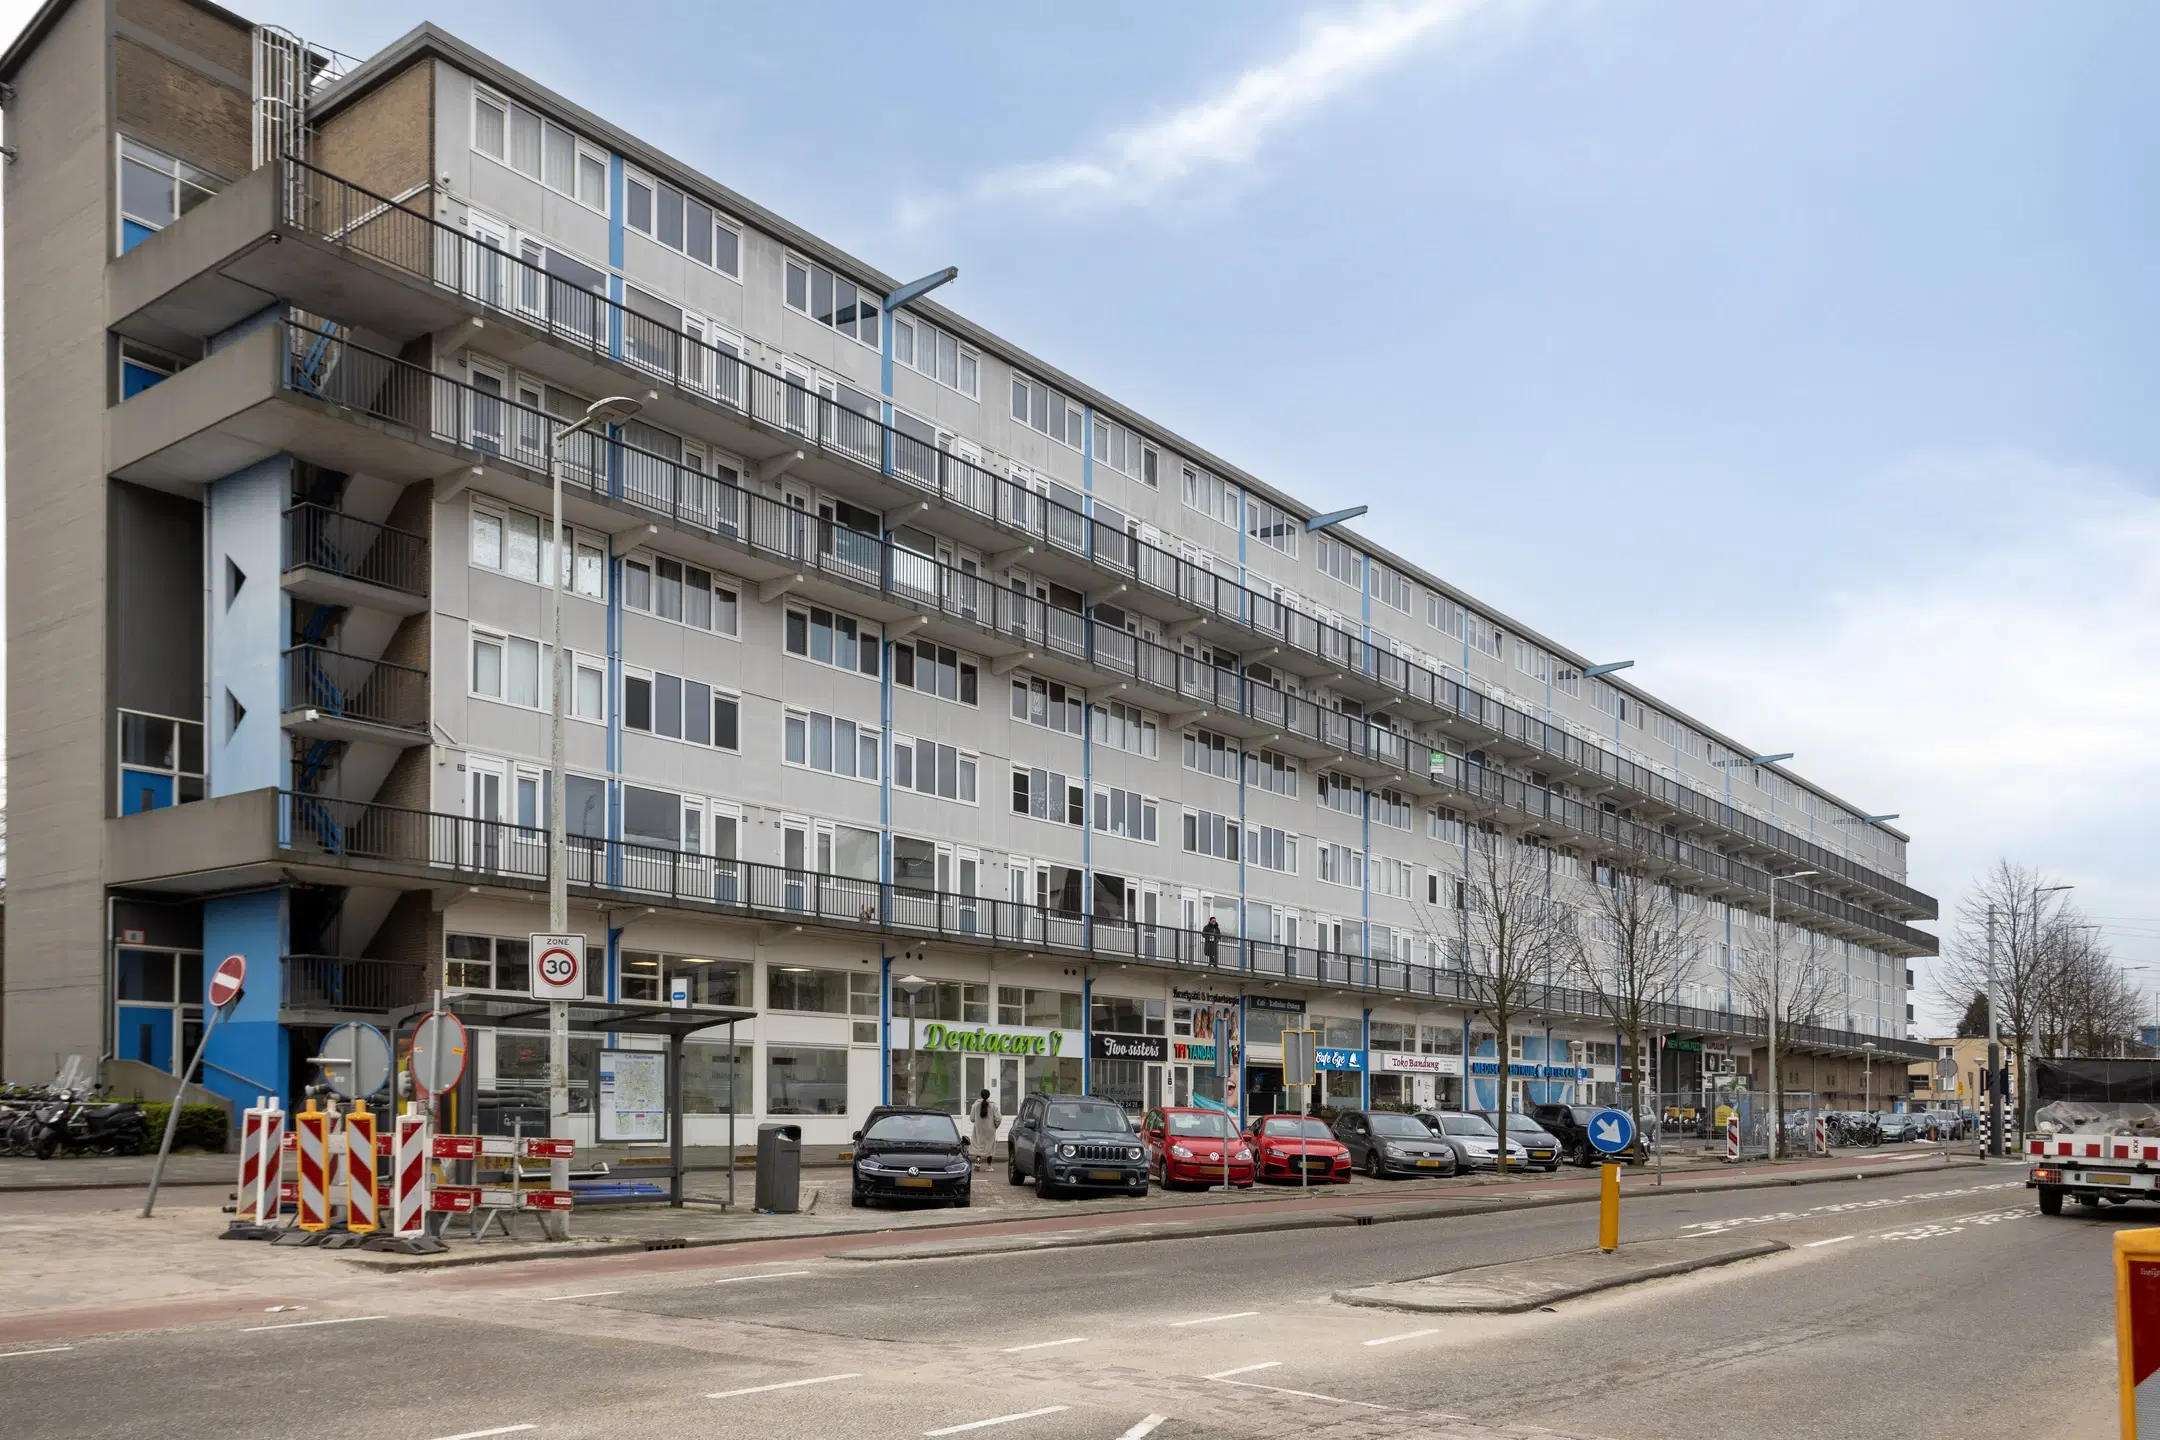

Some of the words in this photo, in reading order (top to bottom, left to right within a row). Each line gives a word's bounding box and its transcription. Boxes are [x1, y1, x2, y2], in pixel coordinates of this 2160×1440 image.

[546, 938, 570, 946] ZONE
[545, 959, 572, 975] 30
[923, 1023, 1046, 1055] Dentacare
[1104, 1037, 1127, 1056] Two
[1174, 1043, 1187, 1059] TRI
[1391, 1055, 1409, 1068] Toko
[1409, 1056, 1440, 1071] Bandung
